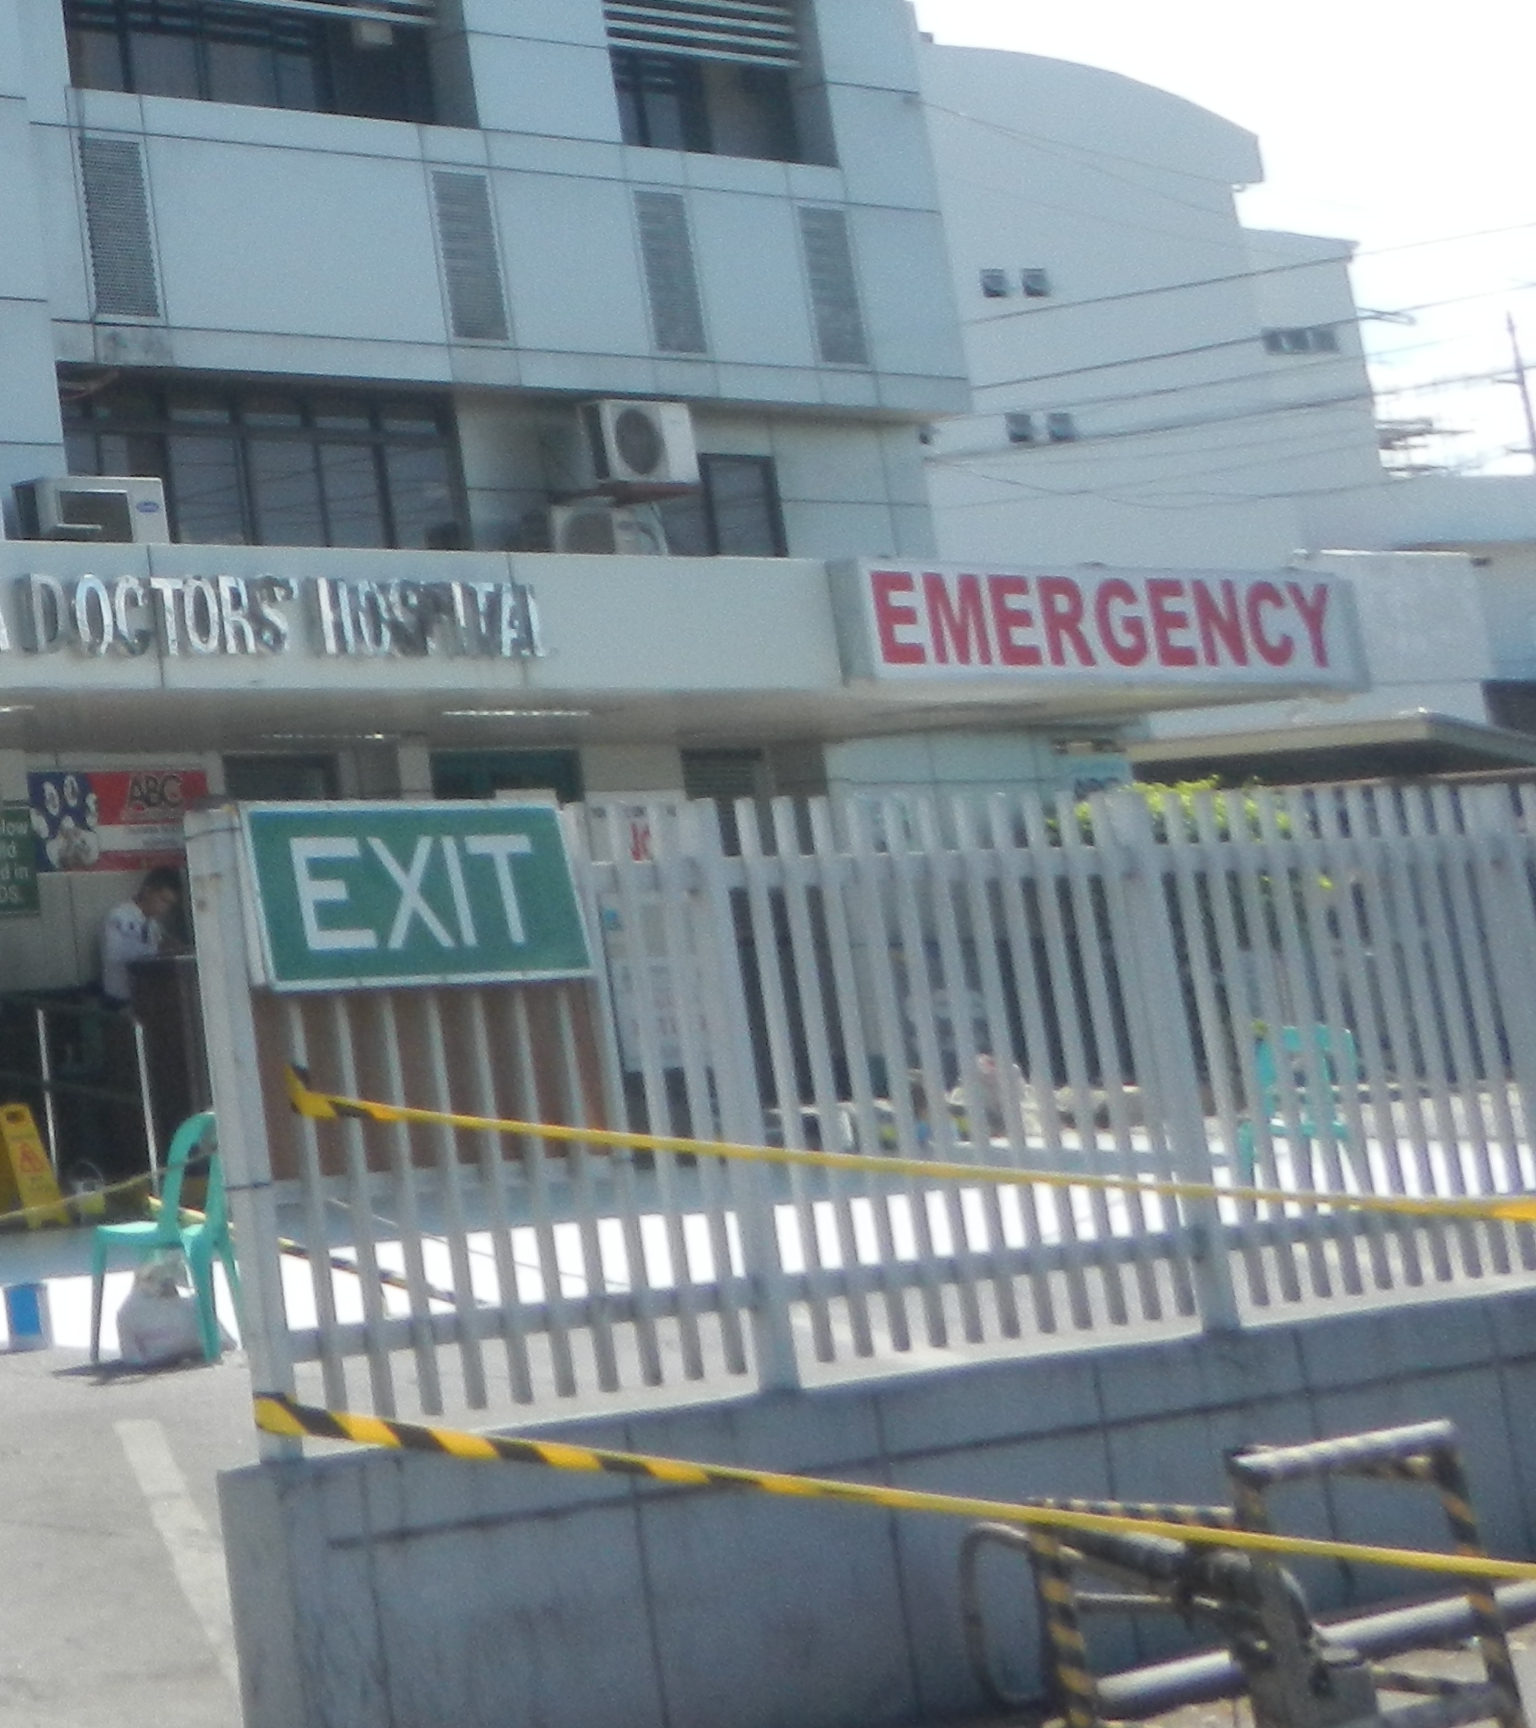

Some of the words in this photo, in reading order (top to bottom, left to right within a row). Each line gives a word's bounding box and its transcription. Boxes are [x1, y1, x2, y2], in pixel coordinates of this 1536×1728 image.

[871, 571, 1329, 668] EMERGENCY
[129, 774, 184, 808] ABC
[13, 862, 29, 879] in
[289, 835, 532, 950] EXIT
